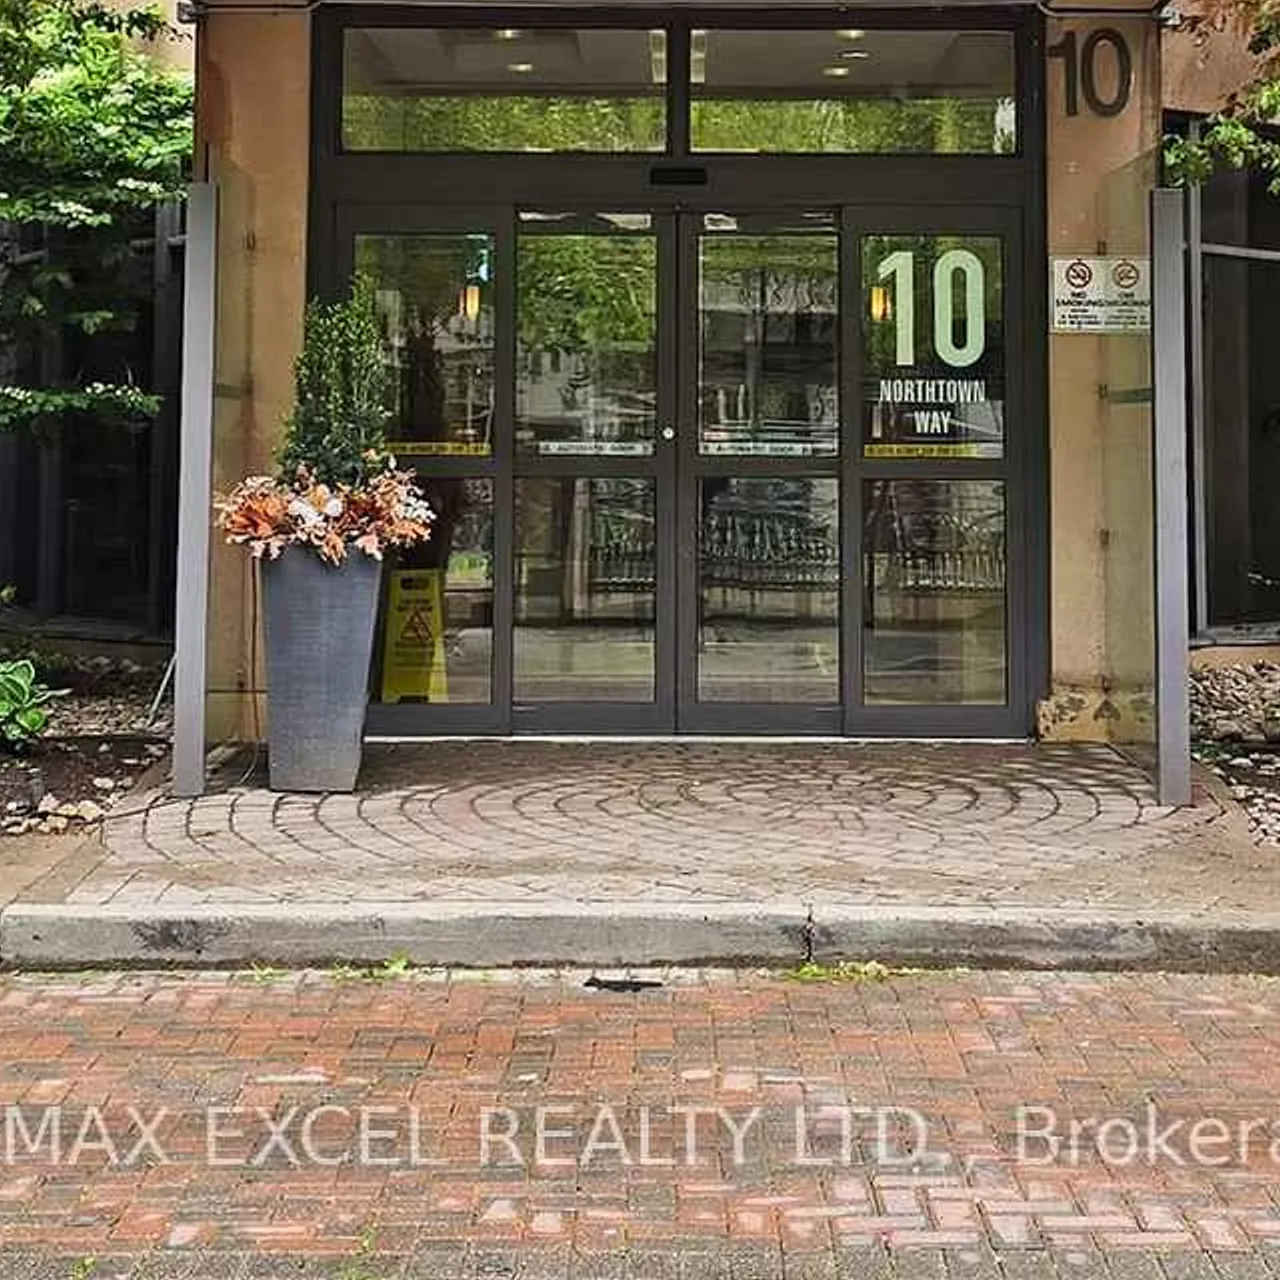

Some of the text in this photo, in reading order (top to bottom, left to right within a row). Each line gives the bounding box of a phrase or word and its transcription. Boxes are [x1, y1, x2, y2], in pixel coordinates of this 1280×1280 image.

[1048, 28, 1132, 117] 10
[877, 249, 985, 367] 10
[879, 379, 986, 402] NORTHTOWN
[914, 410, 951, 433] WAY
